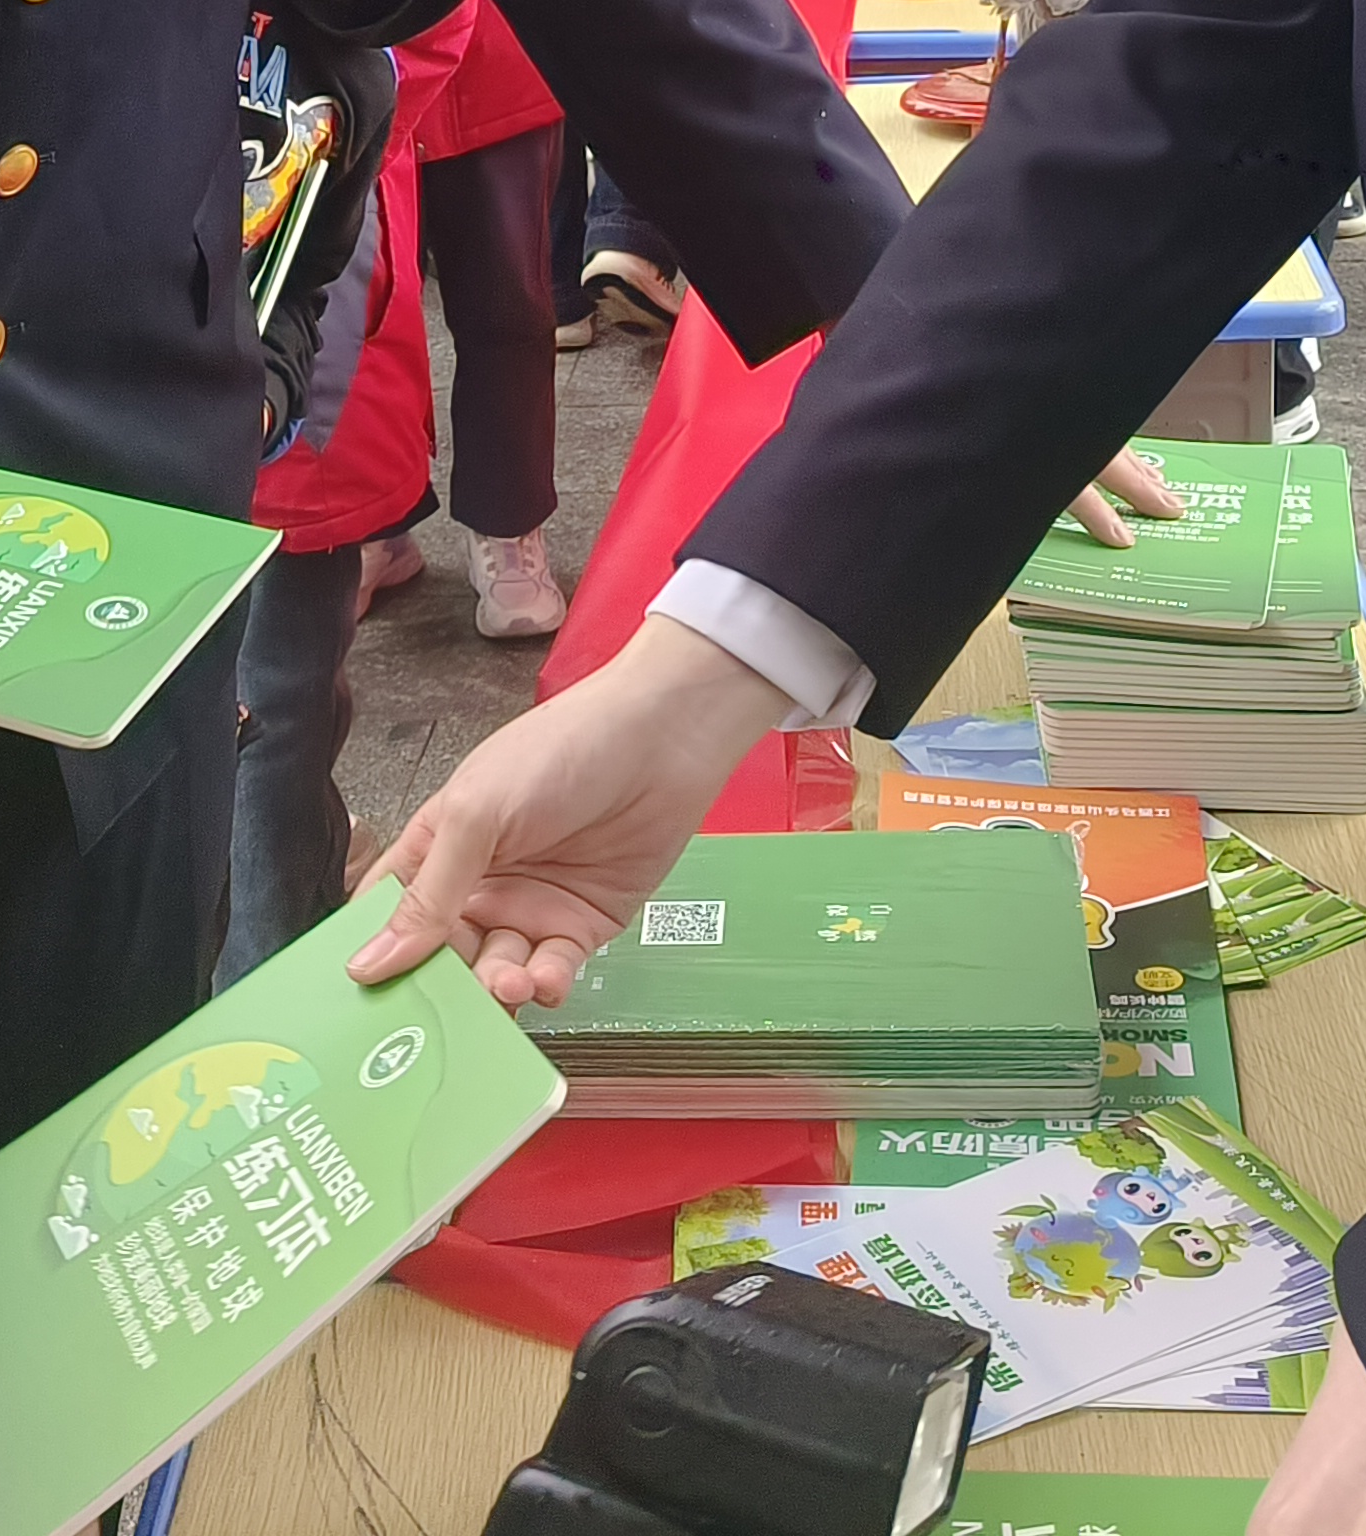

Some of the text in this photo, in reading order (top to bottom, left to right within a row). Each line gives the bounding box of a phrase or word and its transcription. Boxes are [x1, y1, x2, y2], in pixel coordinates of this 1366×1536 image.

[1164, 481, 1248, 494] NXIBEN
[1101, 1028, 1188, 1043] SMOK
[1101, 1041, 1195, 1078] NO
[222, 1135, 332, 1279] 练习本
[285, 1103, 375, 1227] LIANXIBEN
[115, 1230, 179, 1333] 珍爱美丽地球
[167, 1185, 265, 1324] 保护地球
[862, 1233, 1025, 1393] 保态环境
